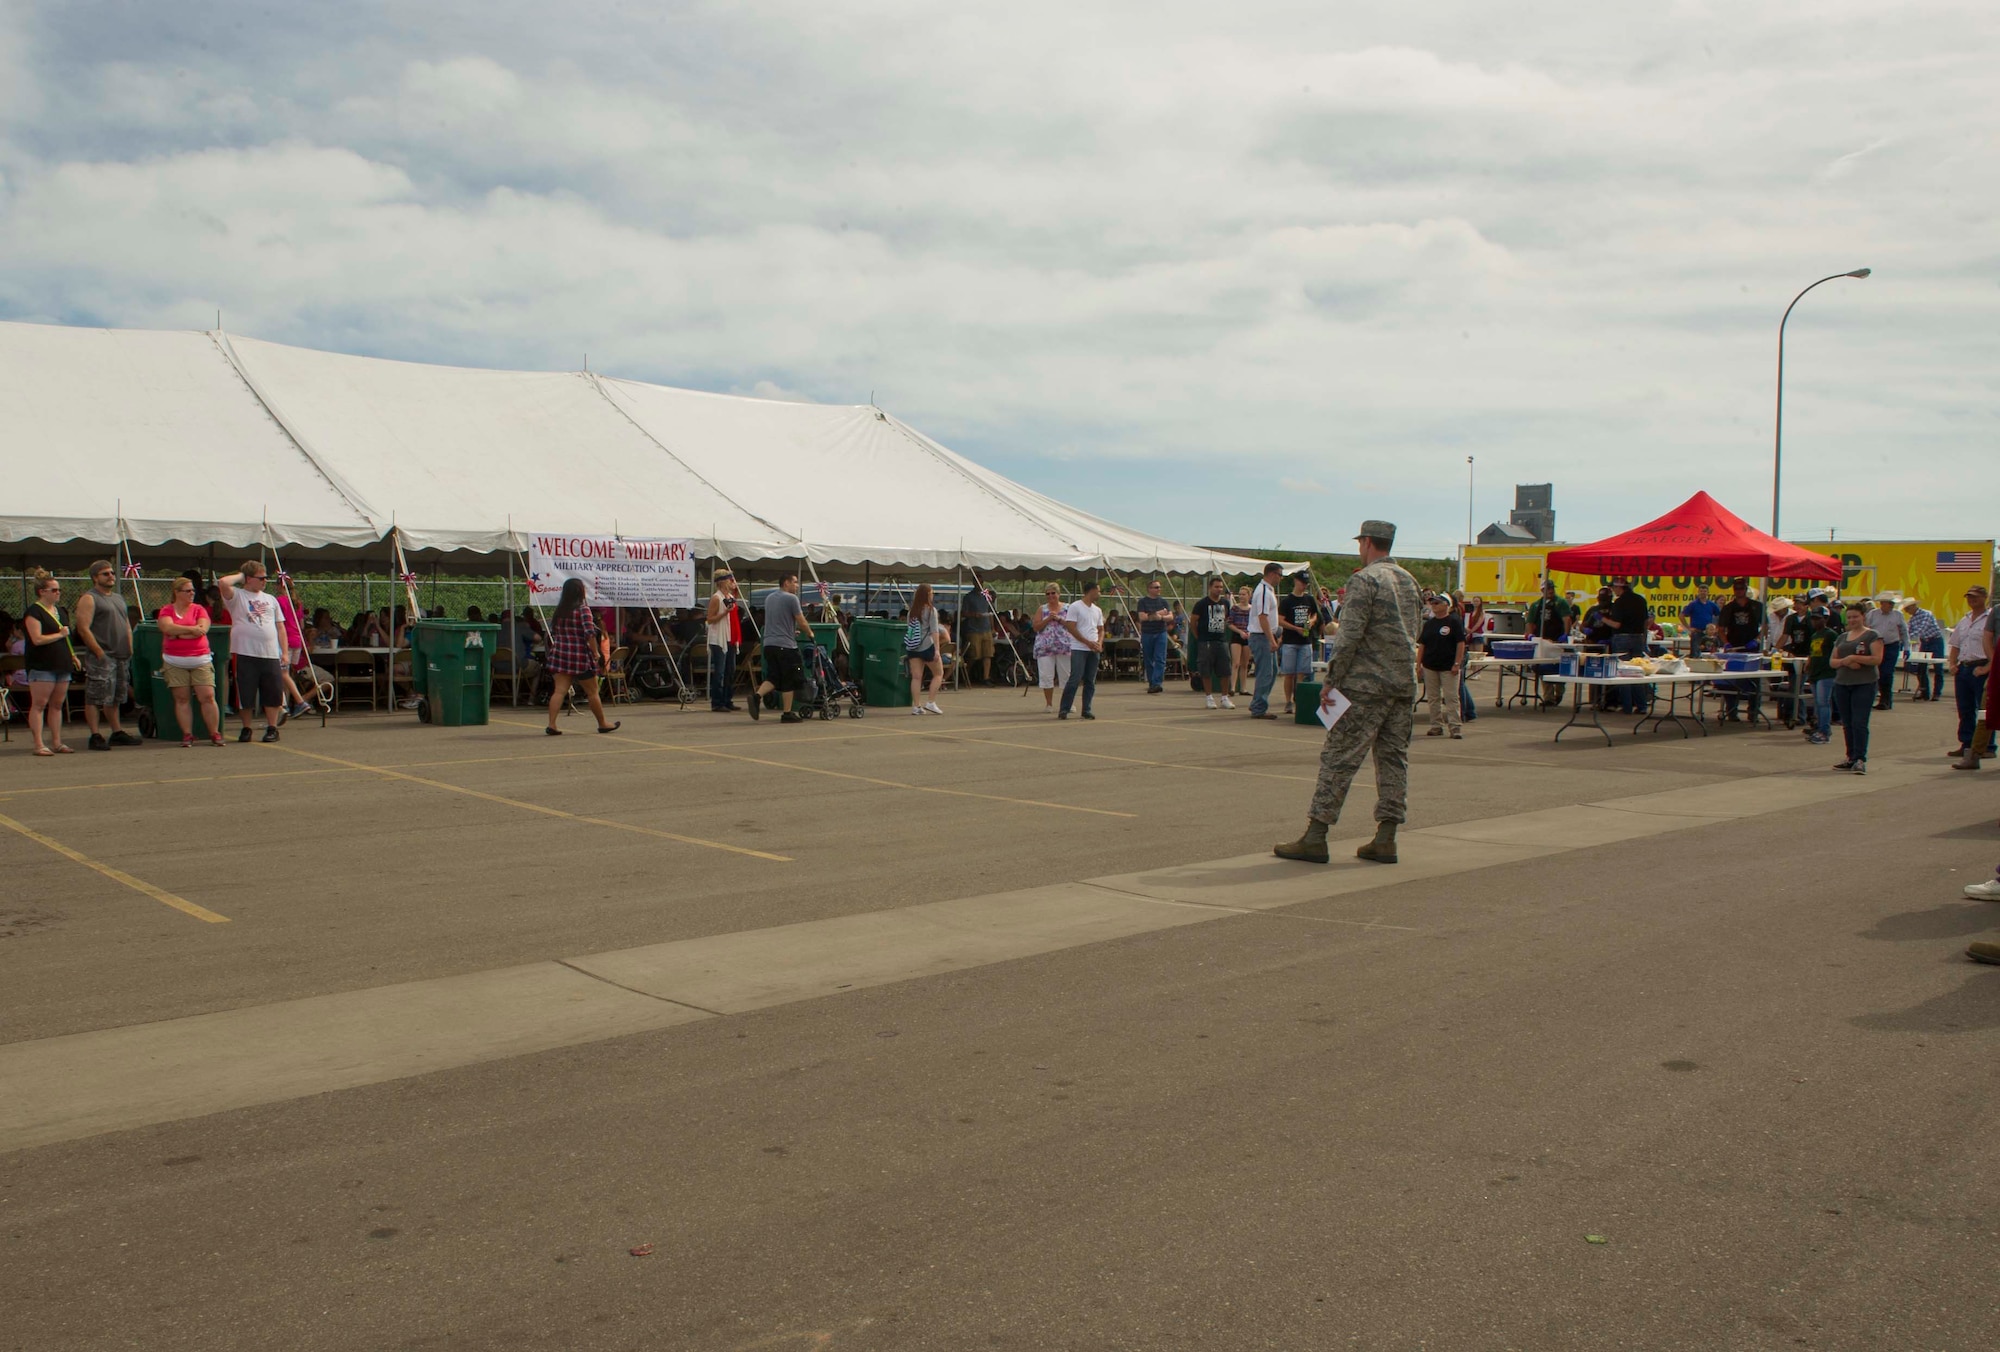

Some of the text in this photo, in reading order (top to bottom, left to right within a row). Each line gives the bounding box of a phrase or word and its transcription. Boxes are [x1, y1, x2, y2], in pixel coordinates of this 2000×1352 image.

[1624, 535, 1710, 545] TRAEGER
[537, 536, 687, 561] WELCOME MILITARY
[553, 562, 675, 574] MILITARY APPRECIATION DAY
[1596, 555, 1714, 575] TRAEGER
[1650, 593, 1680, 601] NORTH
